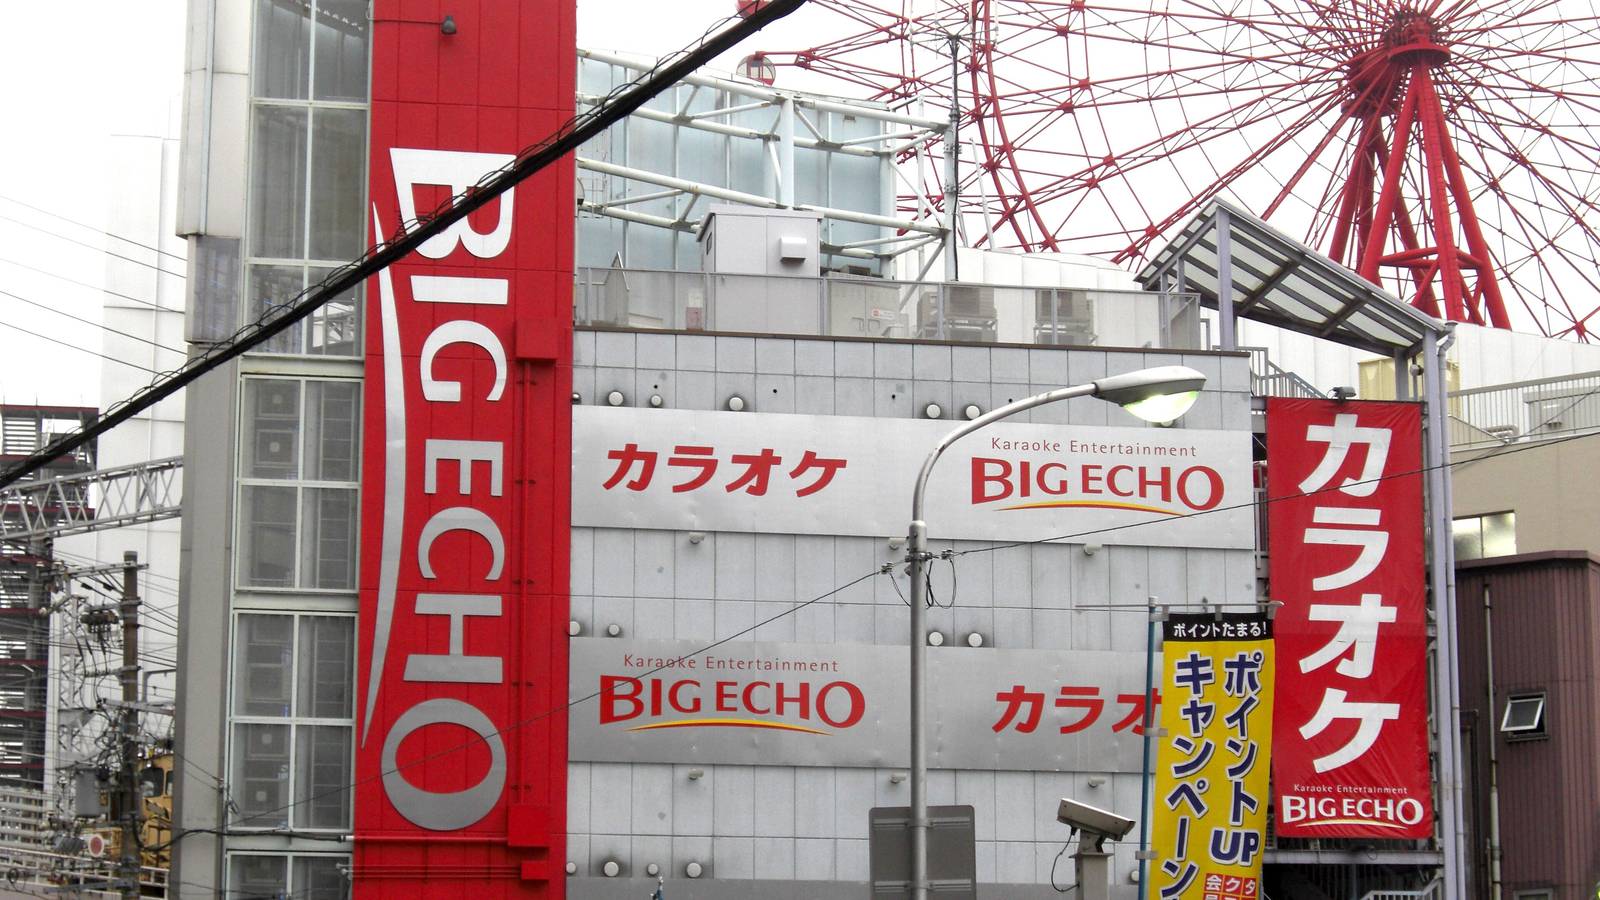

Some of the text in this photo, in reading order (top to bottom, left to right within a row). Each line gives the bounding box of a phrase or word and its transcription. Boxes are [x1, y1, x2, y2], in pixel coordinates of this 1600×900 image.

[602, 443, 848, 498] カラオケ
[991, 437, 1197, 457] Karaoke Entertainment
[380, 147, 517, 832] BIG ECHO
[971, 457, 1225, 511] BIG ECHO
[1298, 413, 1401, 774] カラオケ
[1173, 621, 1267, 638] ポイントたまる!
[623, 654, 839, 672] Karaoke Entertainment
[600, 675, 866, 728] BIG ECHO
[992, 685, 1162, 735] カラオ
[1160, 651, 1215, 900] キャンペーン
[1209, 650, 1264, 865] ポイントUP
[1282, 795, 1424, 825] BIG ECHO
[1294, 784, 1408, 794] Karaoke Entertainment
